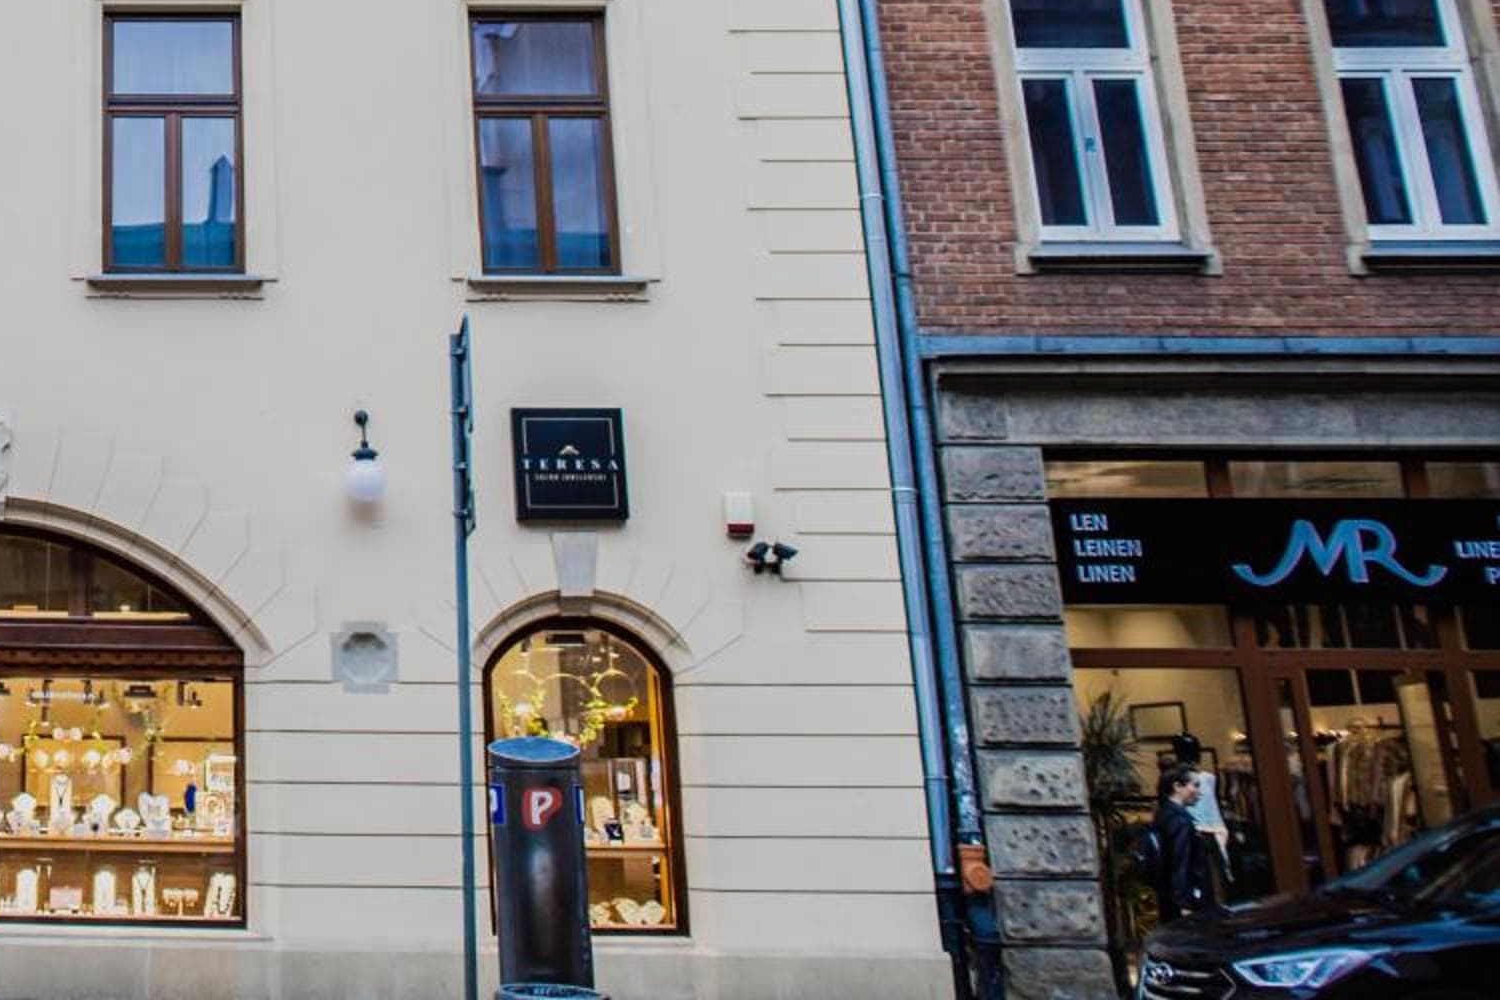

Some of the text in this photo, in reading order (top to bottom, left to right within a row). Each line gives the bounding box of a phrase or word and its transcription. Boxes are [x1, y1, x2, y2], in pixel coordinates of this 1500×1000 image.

[522, 458, 619, 471] TERESA
[1070, 513, 1109, 531] LEN
[1074, 539, 1143, 557] LEINEN
[1231, 519, 1449, 587] MR
[1077, 565, 1136, 583] LINEN
[531, 791, 553, 825] P
